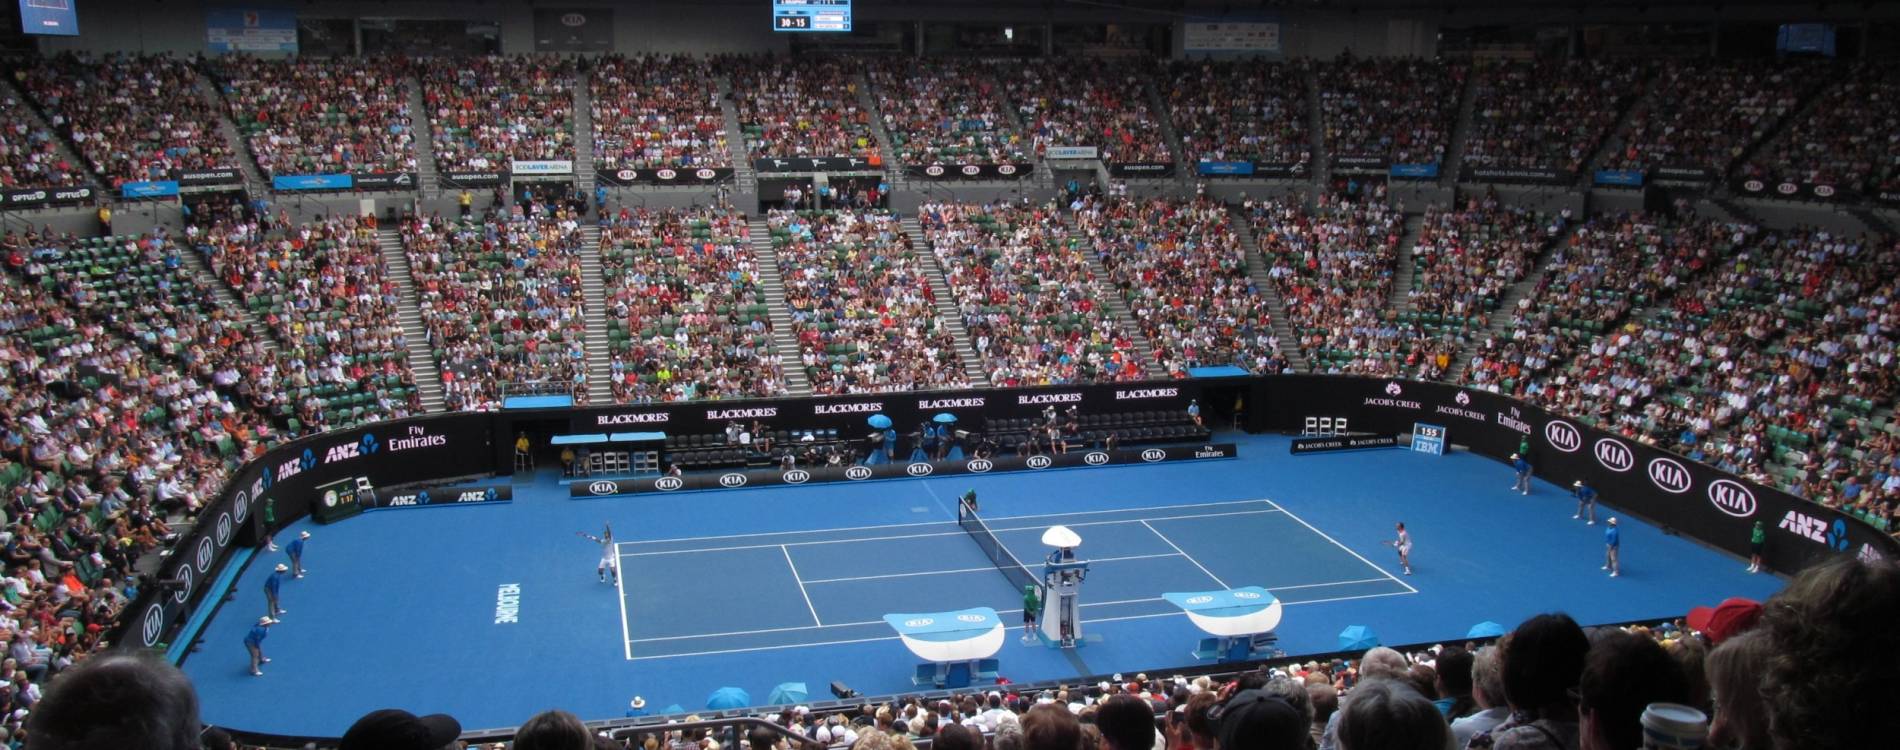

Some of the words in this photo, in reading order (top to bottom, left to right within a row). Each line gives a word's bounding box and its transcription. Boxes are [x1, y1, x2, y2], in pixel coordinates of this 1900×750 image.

[781, 18, 791, 28] 30
[796, 18, 805, 28] 15
[183, 171, 233, 181] ausopen.com
[452, 173, 499, 181] ausopen.com
[12, 193, 37, 202] OPTUS
[56, 191, 80, 199] OPTUS
[1018, 393, 1081, 404] BLACKMORES
[1116, 388, 1177, 400] BLACKMORES
[815, 403, 882, 414] BLACKMORES
[919, 398, 985, 409] BLACKMORES
[1396, 401, 1421, 409] CREEK
[598, 413, 669, 424] BLACKMORES
[707, 408, 777, 420] BLACKMORES
[1465, 411, 1486, 421] CREEK
[1511, 407, 1520, 420] Fly
[1498, 412, 1532, 435] Emirates
[409, 426, 424, 436] Fly
[1422, 427, 1438, 437] 155
[389, 434, 446, 451] Emirates
[1415, 440, 1439, 455] IBM
[325, 441, 360, 463] ANZ
[1196, 450, 1223, 458] Emirates
[277, 458, 302, 482] ANZ
[390, 495, 417, 506] ANZ
[458, 491, 485, 502] ANZ
[1778, 510, 1828, 544] ANZ
